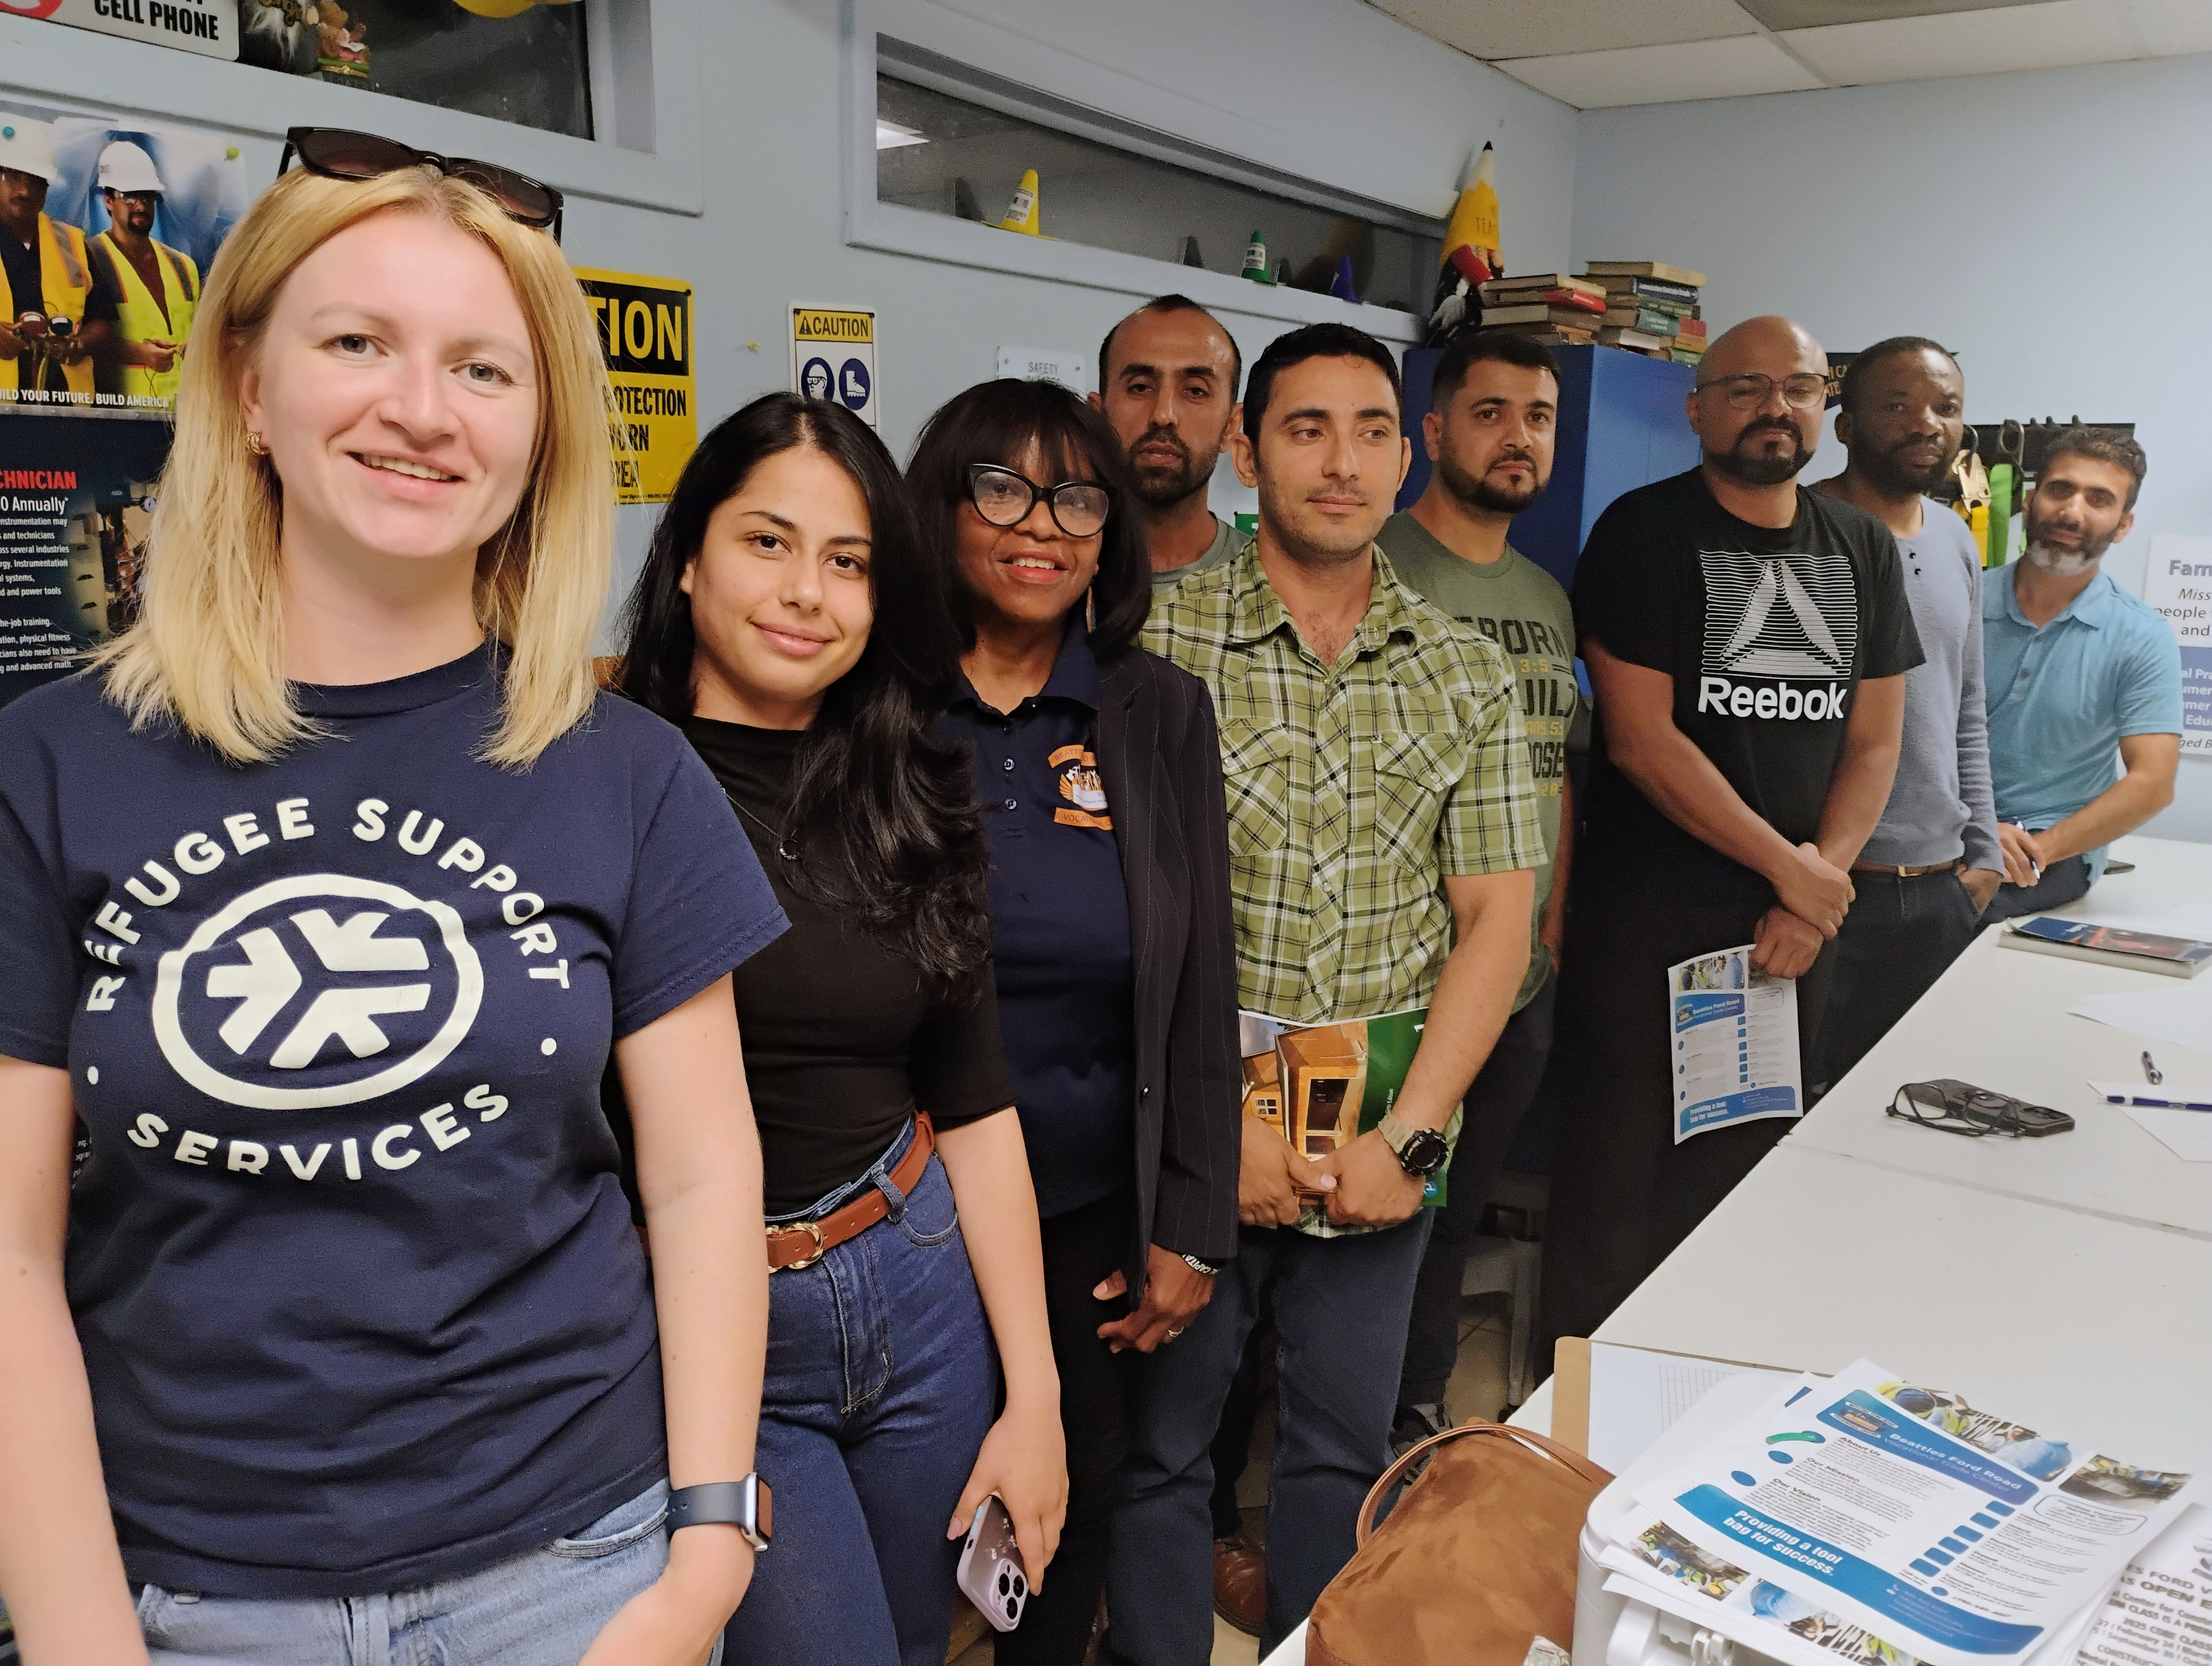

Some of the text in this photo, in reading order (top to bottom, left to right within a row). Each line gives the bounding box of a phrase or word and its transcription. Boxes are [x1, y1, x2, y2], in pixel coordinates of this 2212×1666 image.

[94, 0, 219, 41] CELL PHONE
[813, 317, 869, 337] CAUTION
[1029, 362, 1058, 375] SAFETY
[21, 389, 50, 402] YOUR
[96, 393, 125, 406] BUILD
[53, 518, 68, 527] may
[3, 531, 55, 540] and technicians
[10, 545, 35, 554] several
[36, 544, 70, 553] industries
[14, 559, 68, 568] Instrumentation
[5, 574, 35, 584] systems,
[7, 587, 20, 596] and
[21, 588, 43, 597] power
[44, 586, 62, 595] tools
[20, 633, 47, 644] physical
[48, 633, 71, 641] fitness
[2182, 625, 2210, 636] and
[34, 648, 51, 656] need
[6, 663, 19, 672] and
[21, 661, 53, 671] advanced
[1698, 676, 1847, 720] Reebok
[86, 797, 570, 1011] REFUGEE SUPPORT
[127, 1084, 509, 1181] SERVICES
[1840, 1437, 1868, 1451] About
[1807, 1457, 1861, 1482] Our Mission
[1884, 1438, 2010, 1492] Vocational Trade Center
[1889, 1433, 2022, 1490] Beatties Ford Road
[1773, 1478, 1821, 1502] Our Vision
[1734, 1510, 1844, 1565] Providing a tool
[1722, 1517, 1834, 1577] bag for success.
[2149, 1571, 2195, 1590] FORD
[2140, 1581, 2195, 1603] OPEN
[2129, 1605, 2159, 1620] CLASS
[2123, 1617, 2147, 1630] 2025
